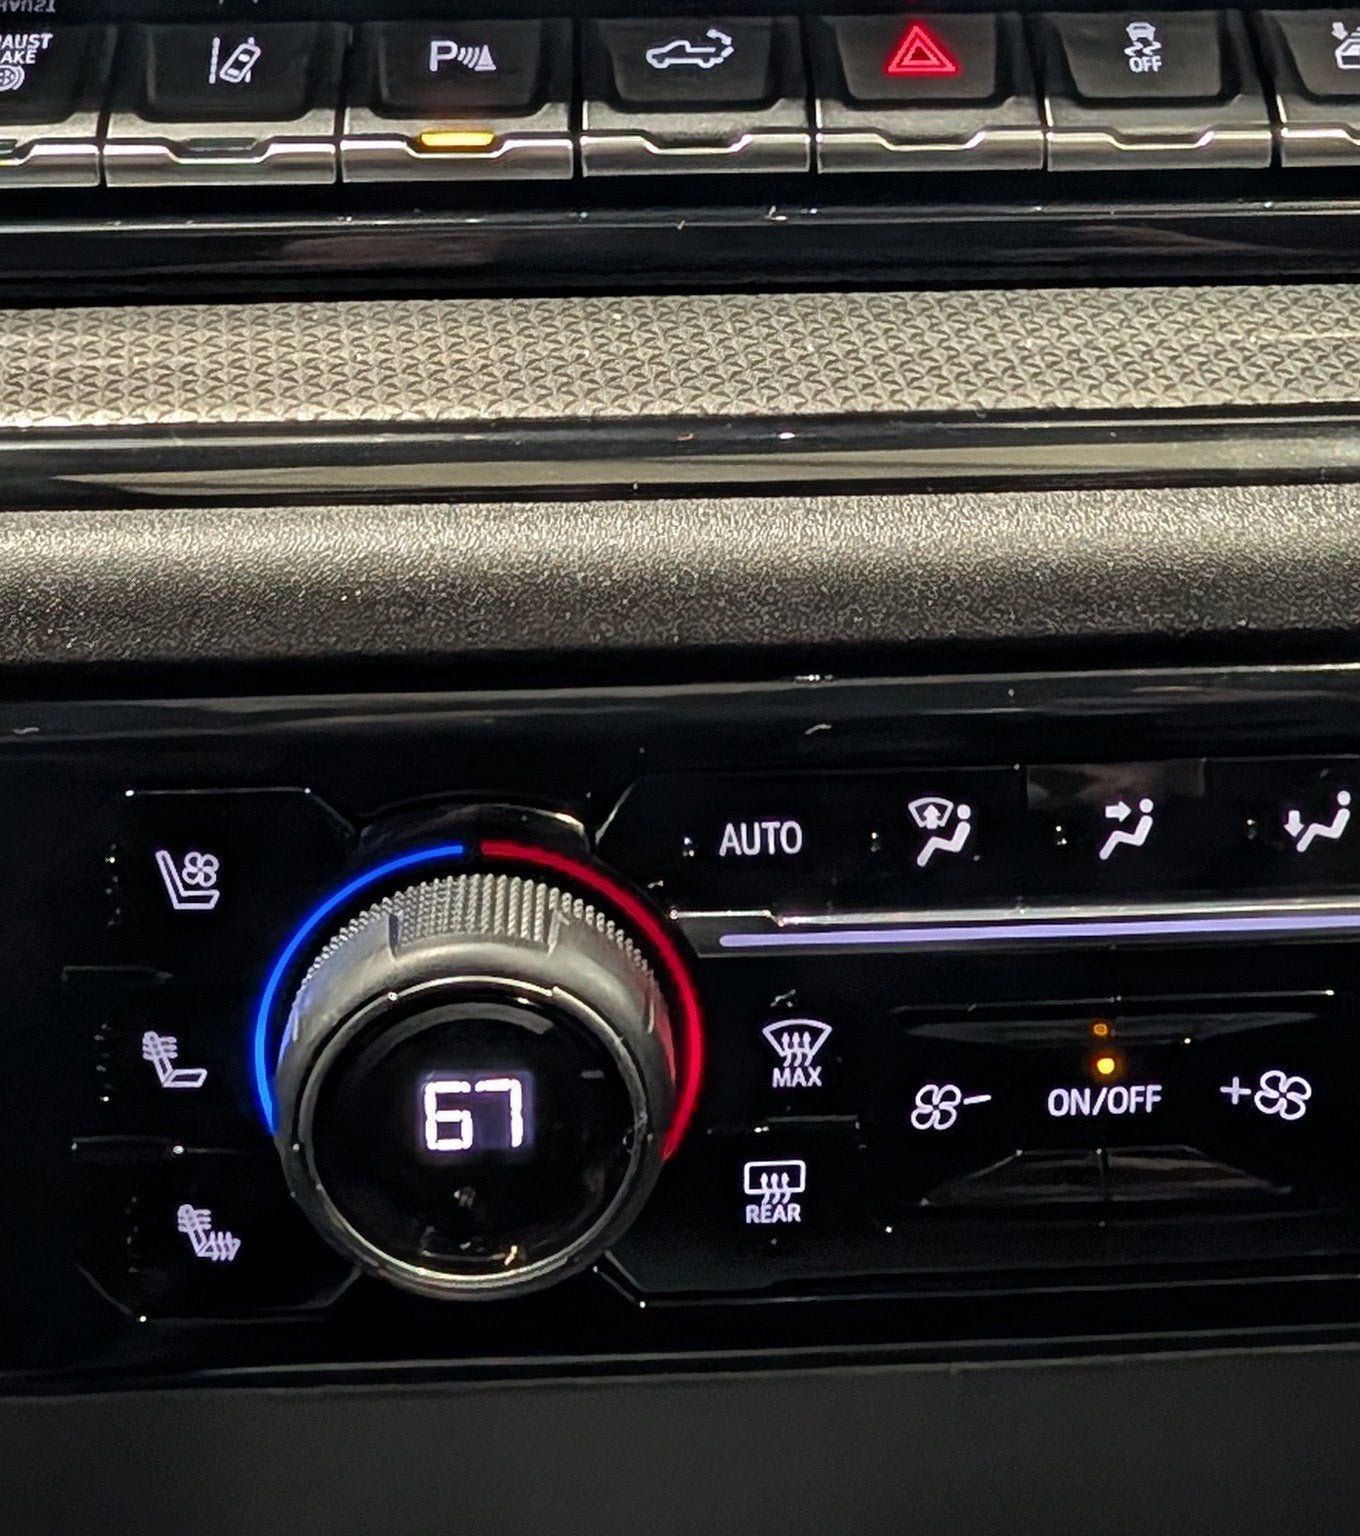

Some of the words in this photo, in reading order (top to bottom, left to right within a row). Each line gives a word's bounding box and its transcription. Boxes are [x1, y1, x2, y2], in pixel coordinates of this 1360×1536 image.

[1129, 55, 1162, 73] OFF
[719, 821, 803, 857] AUTO
[772, 1066, 823, 1090] MAX
[423, 1077, 523, 1151] 67
[1047, 1083, 1163, 1119] ON/OFF
[744, 1203, 802, 1226] REAR
